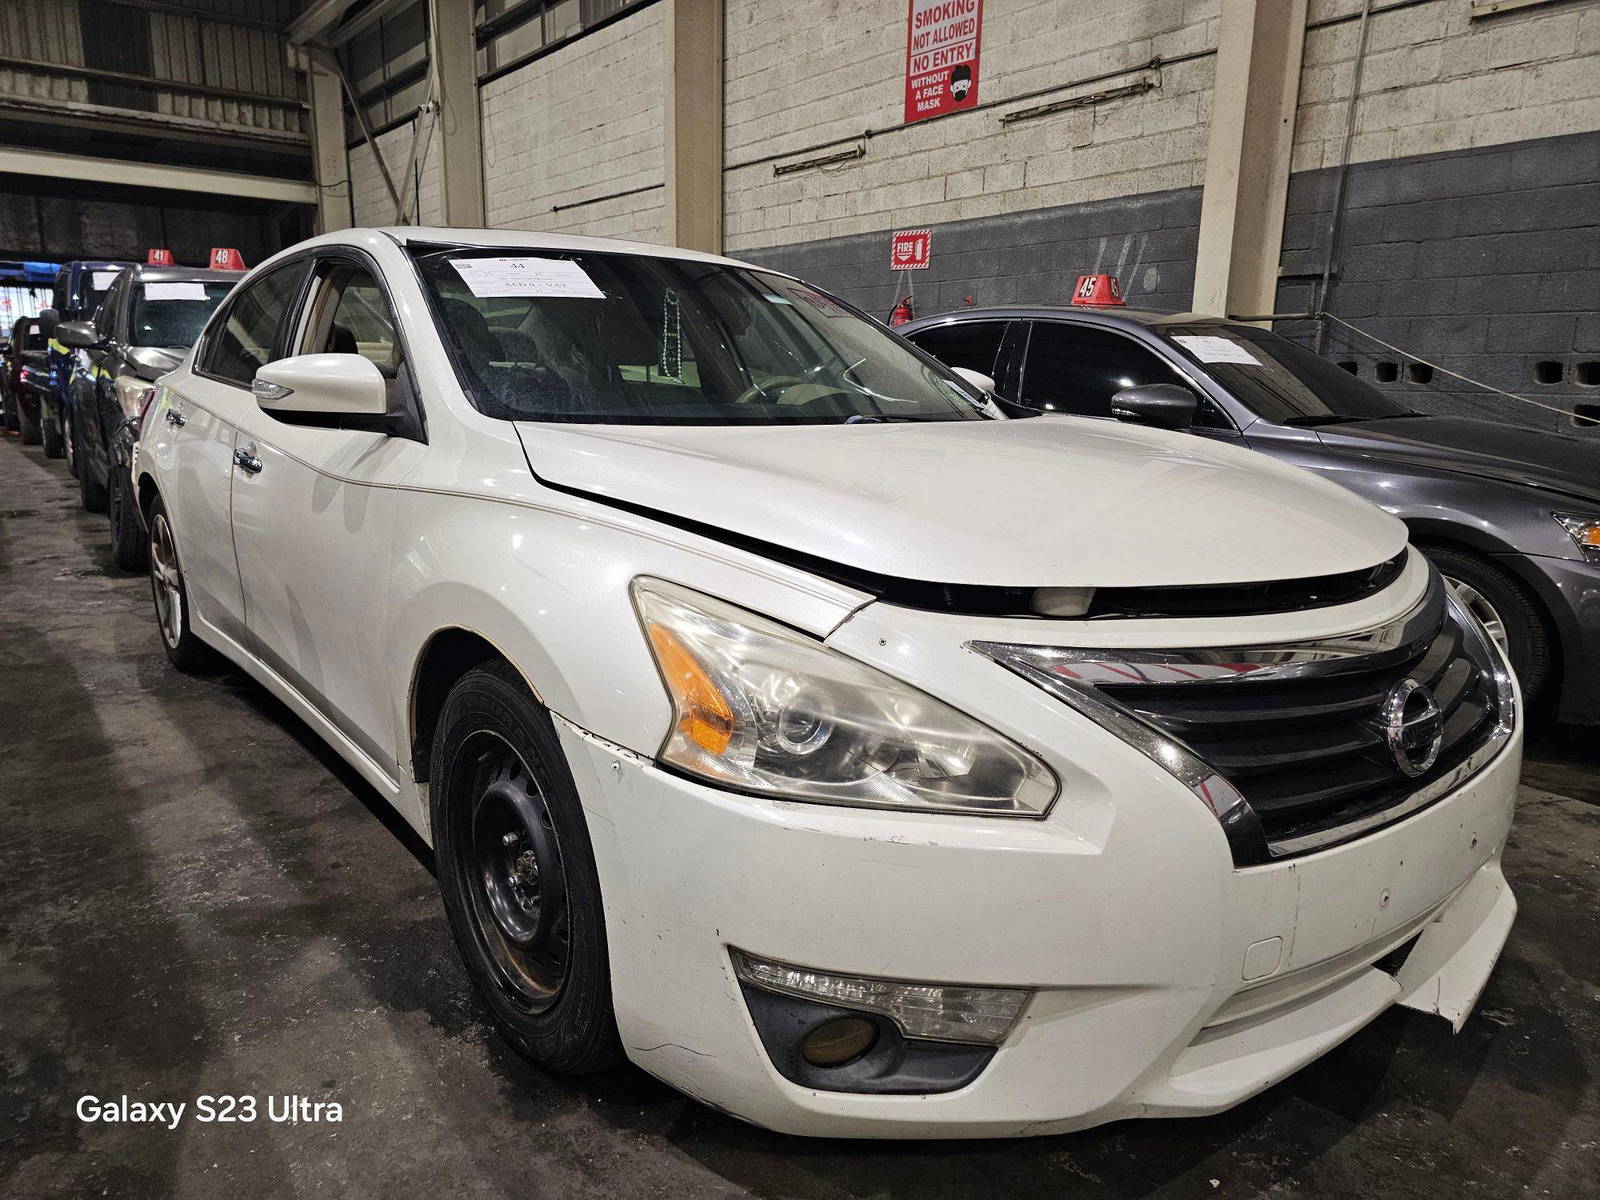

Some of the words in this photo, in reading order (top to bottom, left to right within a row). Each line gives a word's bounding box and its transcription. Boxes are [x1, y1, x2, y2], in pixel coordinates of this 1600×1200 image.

[915, 0, 975, 29] SMOKING
[913, 32, 930, 51] NOT
[932, 18, 975, 45] ALLOWED
[913, 55, 930, 74] NO
[933, 42, 973, 67] ENTRY
[911, 71, 950, 89] WITHOUT
[915, 90, 921, 101] A
[923, 84, 944, 99] FACE
[917, 98, 941, 112] MASK
[154, 249, 164, 260] 41
[897, 242, 914, 253] FIRE
[216, 249, 229, 264] 48
[1080, 277, 1097, 297] 45
